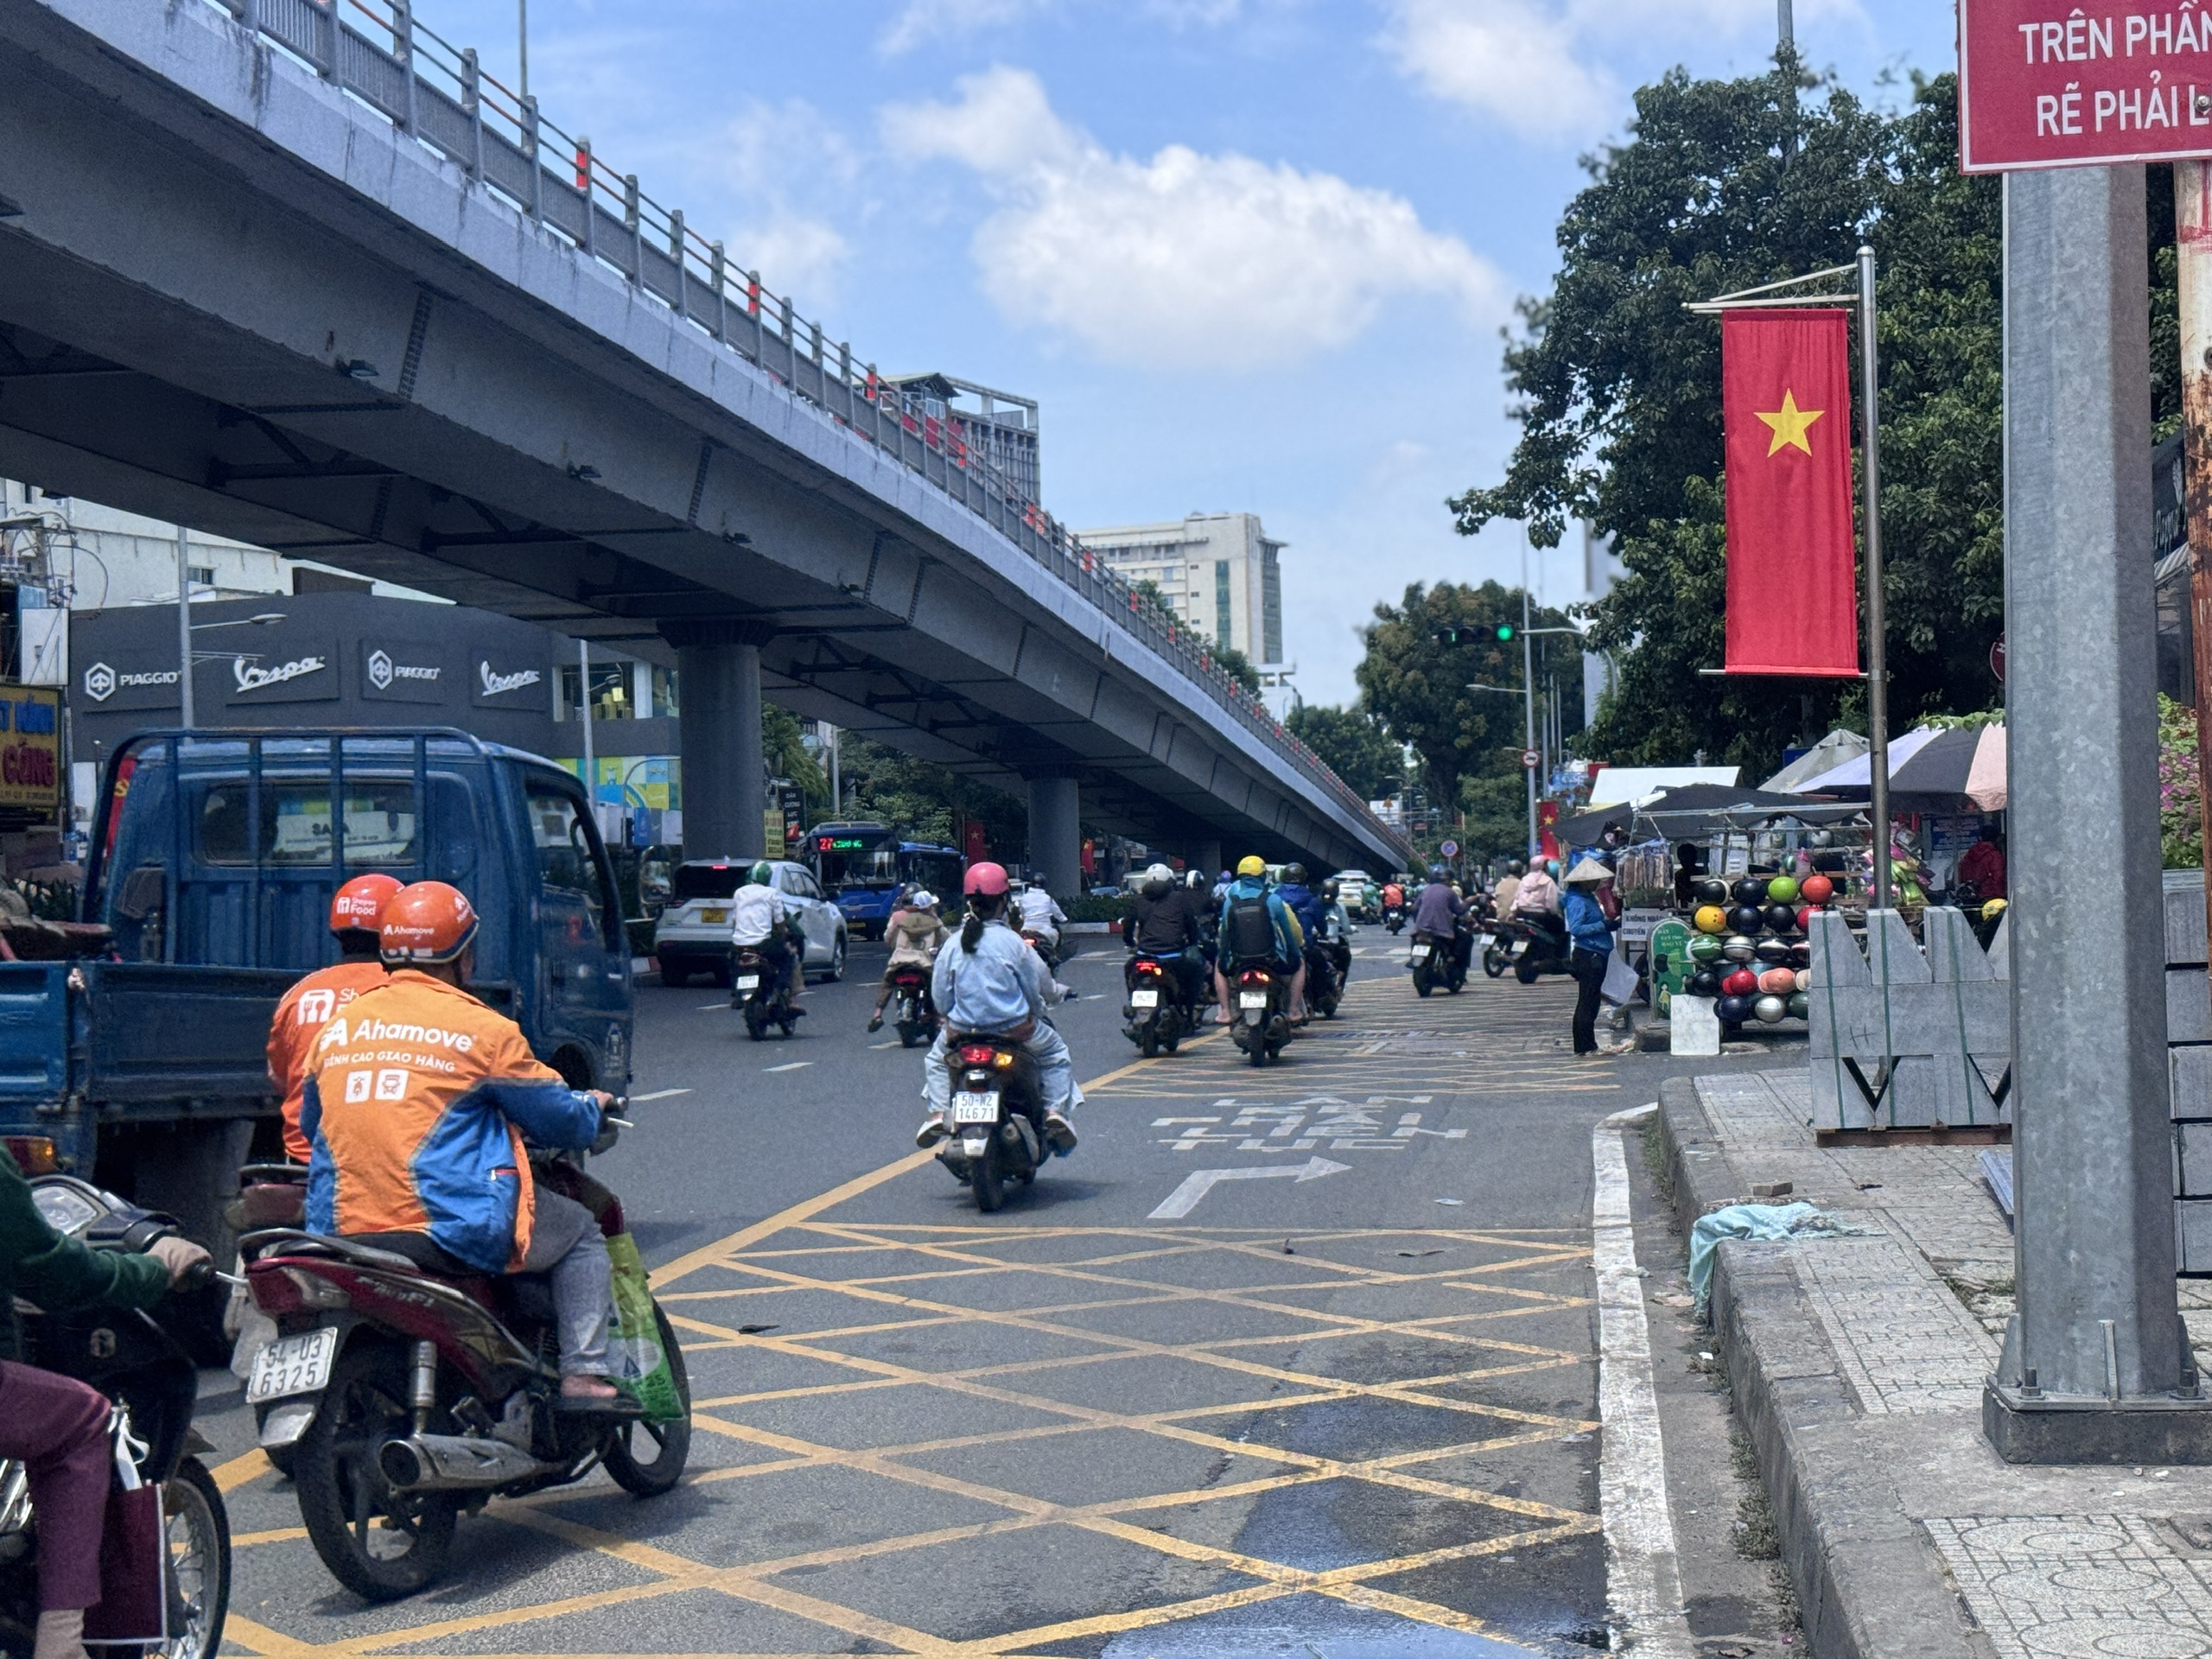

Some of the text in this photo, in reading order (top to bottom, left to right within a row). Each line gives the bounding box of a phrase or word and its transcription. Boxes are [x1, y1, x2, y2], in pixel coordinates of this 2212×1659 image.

[2018, 7, 2113, 65] TRÊN
[2037, 80, 2083, 137] RẼ
[2094, 69, 2179, 132] PHẢI
[119, 671, 178, 686] PIAGGIO
[233, 655, 326, 692] Vespa
[394, 665, 438, 680] PIAGGIO
[480, 660, 541, 696] Vespa
[350, 904, 377, 916] Food
[393, 925, 435, 935] Ahamove
[351, 1018, 474, 1052] Ahamove
[351, 1051, 374, 1064] CAO
[377, 1050, 412, 1064] GIAO
[415, 1053, 456, 1073] HÀNG
[958, 1107, 995, 1120] 14671
[260, 1361, 319, 1395] 6325
